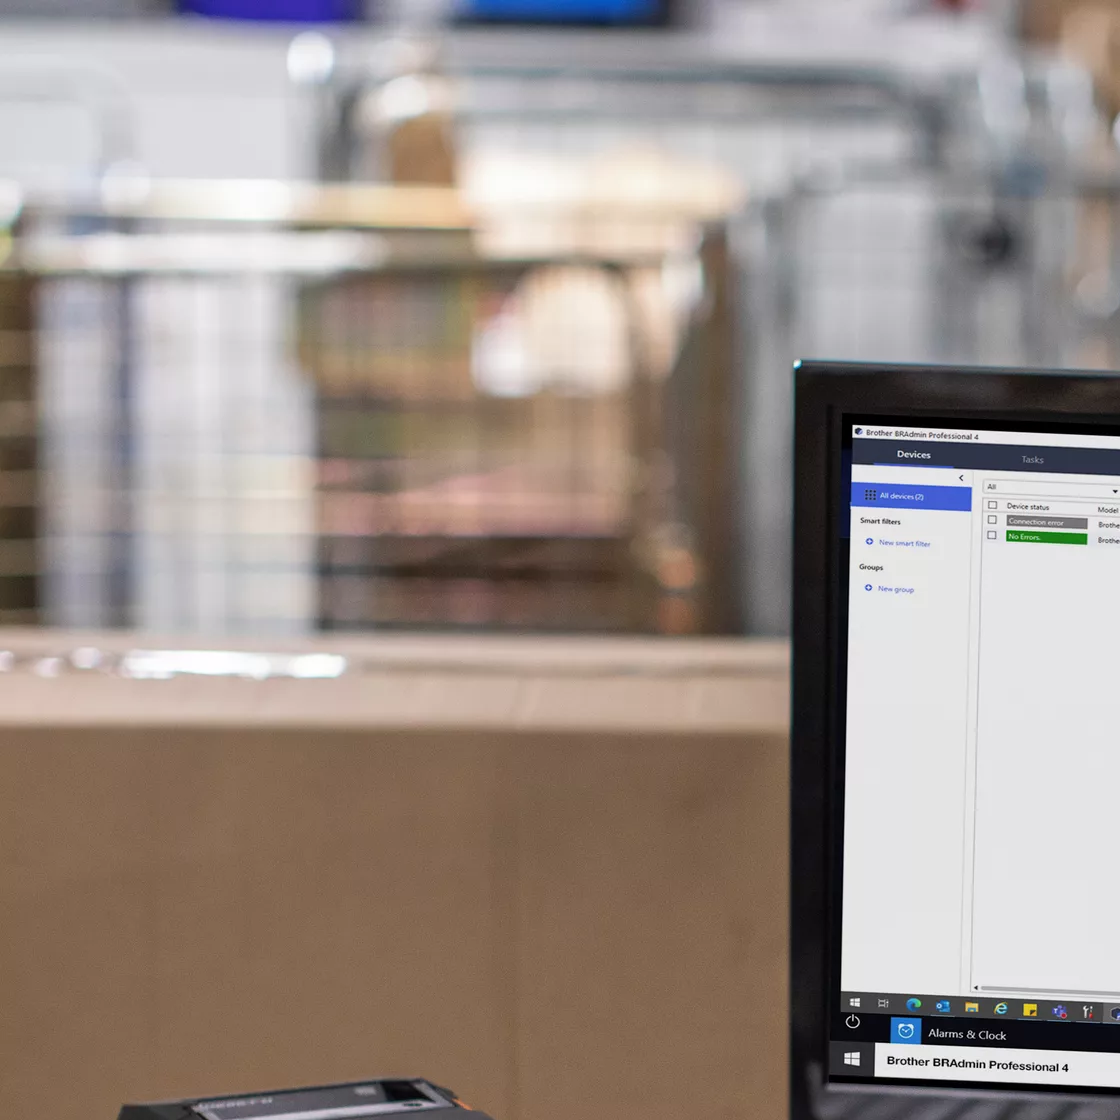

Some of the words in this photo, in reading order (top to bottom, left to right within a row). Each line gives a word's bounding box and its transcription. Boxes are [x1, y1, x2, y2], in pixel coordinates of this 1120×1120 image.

[866, 429, 892, 437] Brother
[928, 432, 972, 440] Professional
[897, 450, 931, 459] Devices
[1022, 456, 1044, 464] Tasks
[890, 492, 914, 500] devices
[915, 493, 924, 501] (2)
[859, 563, 884, 572] Groups
[928, 1028, 964, 1039] Alarms
[966, 1030, 976, 1040] &
[978, 1030, 1006, 1040] Clock
[887, 1056, 930, 1068] Brother
[932, 1058, 986, 1070] BRAdmin
[989, 1060, 1060, 1073] Professional
[1062, 1063, 1069, 1073] 4
